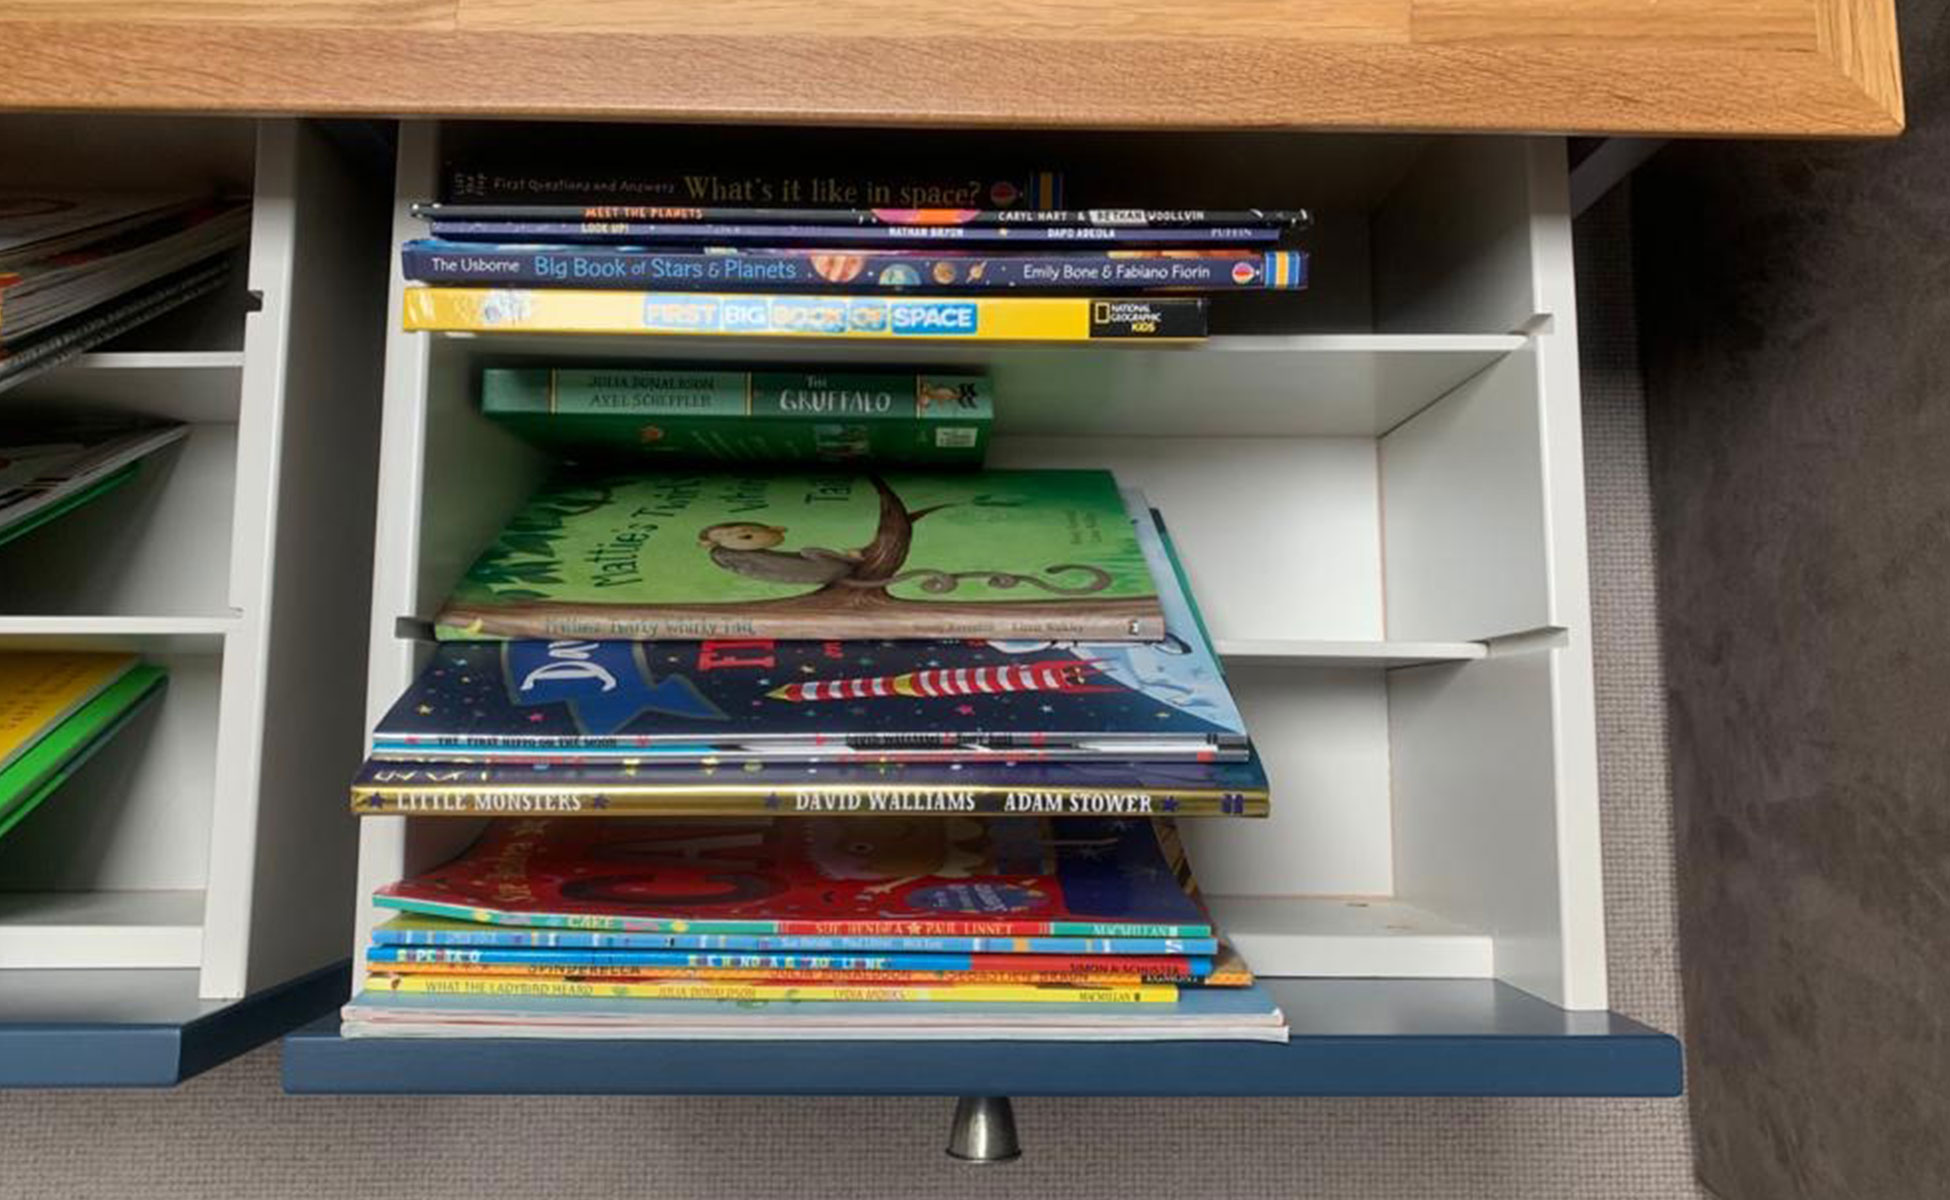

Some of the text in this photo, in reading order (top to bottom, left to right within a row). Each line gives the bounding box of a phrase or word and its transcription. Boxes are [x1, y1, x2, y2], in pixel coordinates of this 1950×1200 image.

[493, 177, 525, 191] First
[528, 178, 590, 195] Questions
[617, 179, 675, 194] Answers
[683, 176, 773, 202] What's
[783, 179, 801, 203] it
[811, 178, 857, 203] like
[867, 180, 889, 203] in
[899, 180, 982, 209] space?
[585, 206, 618, 219] MEET
[624, 207, 646, 219] THE
[651, 208, 703, 220] PLANETS
[998, 210, 1033, 222] CARYL
[1037, 210, 1067, 222] HART
[1077, 210, 1085, 222] &
[581, 222, 608, 234] LOOK
[889, 228, 927, 239] NATHAN
[1047, 229, 1074, 240] DAPO
[432, 256, 1210, 282] The Usborne Big Book of Stars & Planets Emily Bone & Fabiano Fiorin
[724, 305, 765, 325] BIG
[894, 306, 973, 328] SPACE
[1111, 302, 1150, 314] NATIONAL
[1111, 312, 1161, 323] GEOGRAPHIC
[1131, 321, 1156, 334] KIDS
[779, 389, 892, 413] GRUFFALO
[586, 521, 659, 589] Mattie's
[396, 792, 1153, 813] LITTLE MONSTERS DAVID WALLIAMS ADAM STOWER
[566, 915, 615, 930] CAKE
[815, 923, 840, 936] SUE
[424, 980, 460, 993] WHAT
[465, 981, 486, 994] THE
[488, 982, 549, 995] LADYBIRD
